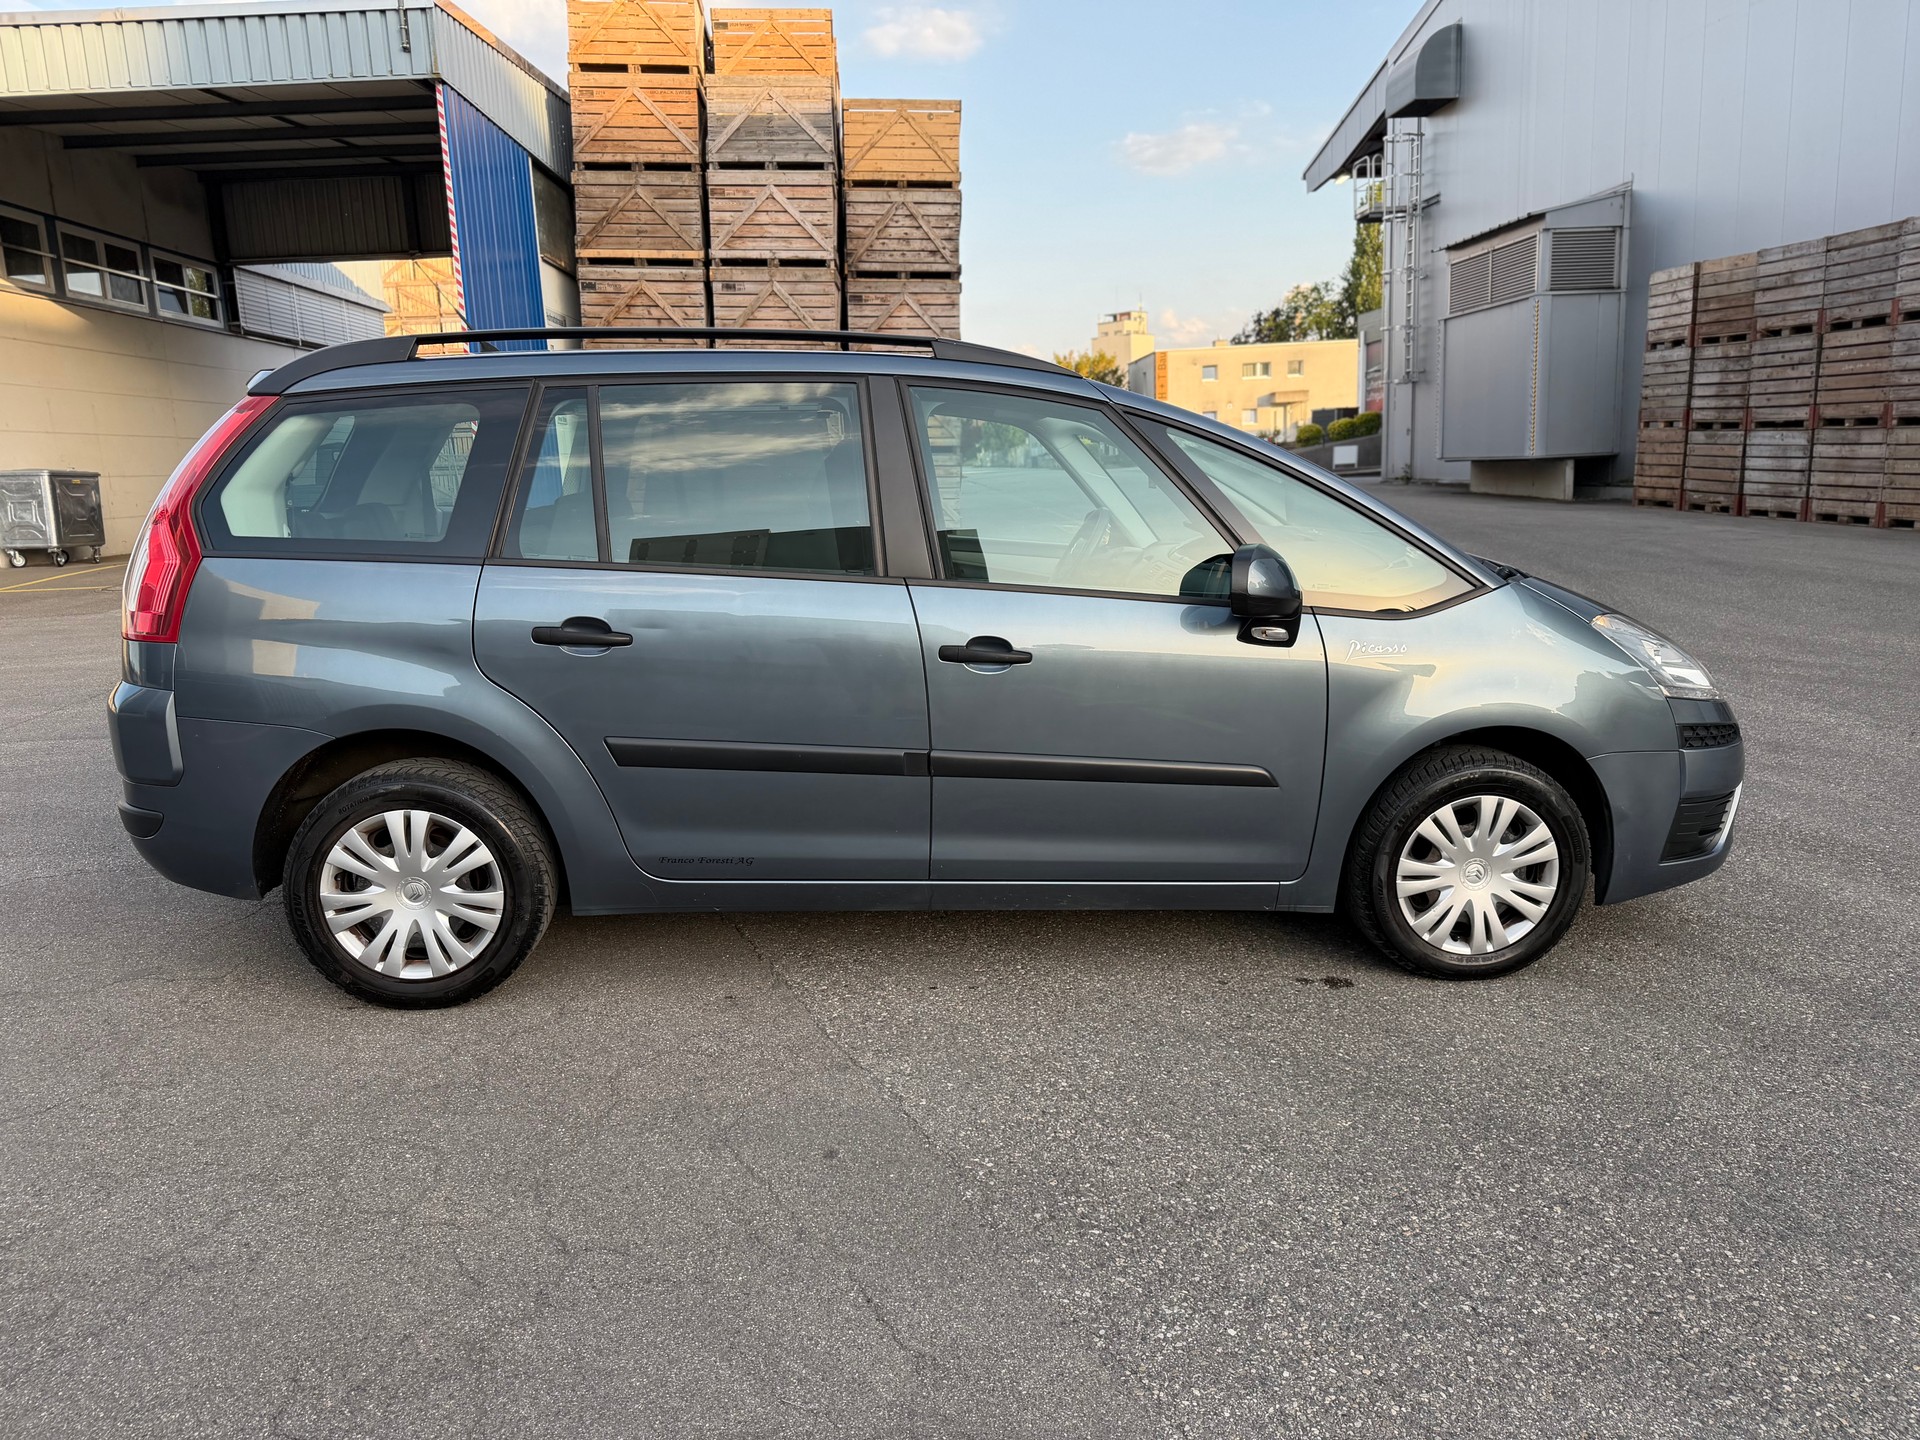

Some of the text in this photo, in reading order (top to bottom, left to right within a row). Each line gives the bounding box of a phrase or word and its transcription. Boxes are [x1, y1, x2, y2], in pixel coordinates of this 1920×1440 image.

[1157, 351, 1167, 371] Bau
[1157, 392, 1167, 400] H
[1344, 639, 1408, 662] Picasso
[658, 856, 754, 866] Franco Foresti AG
